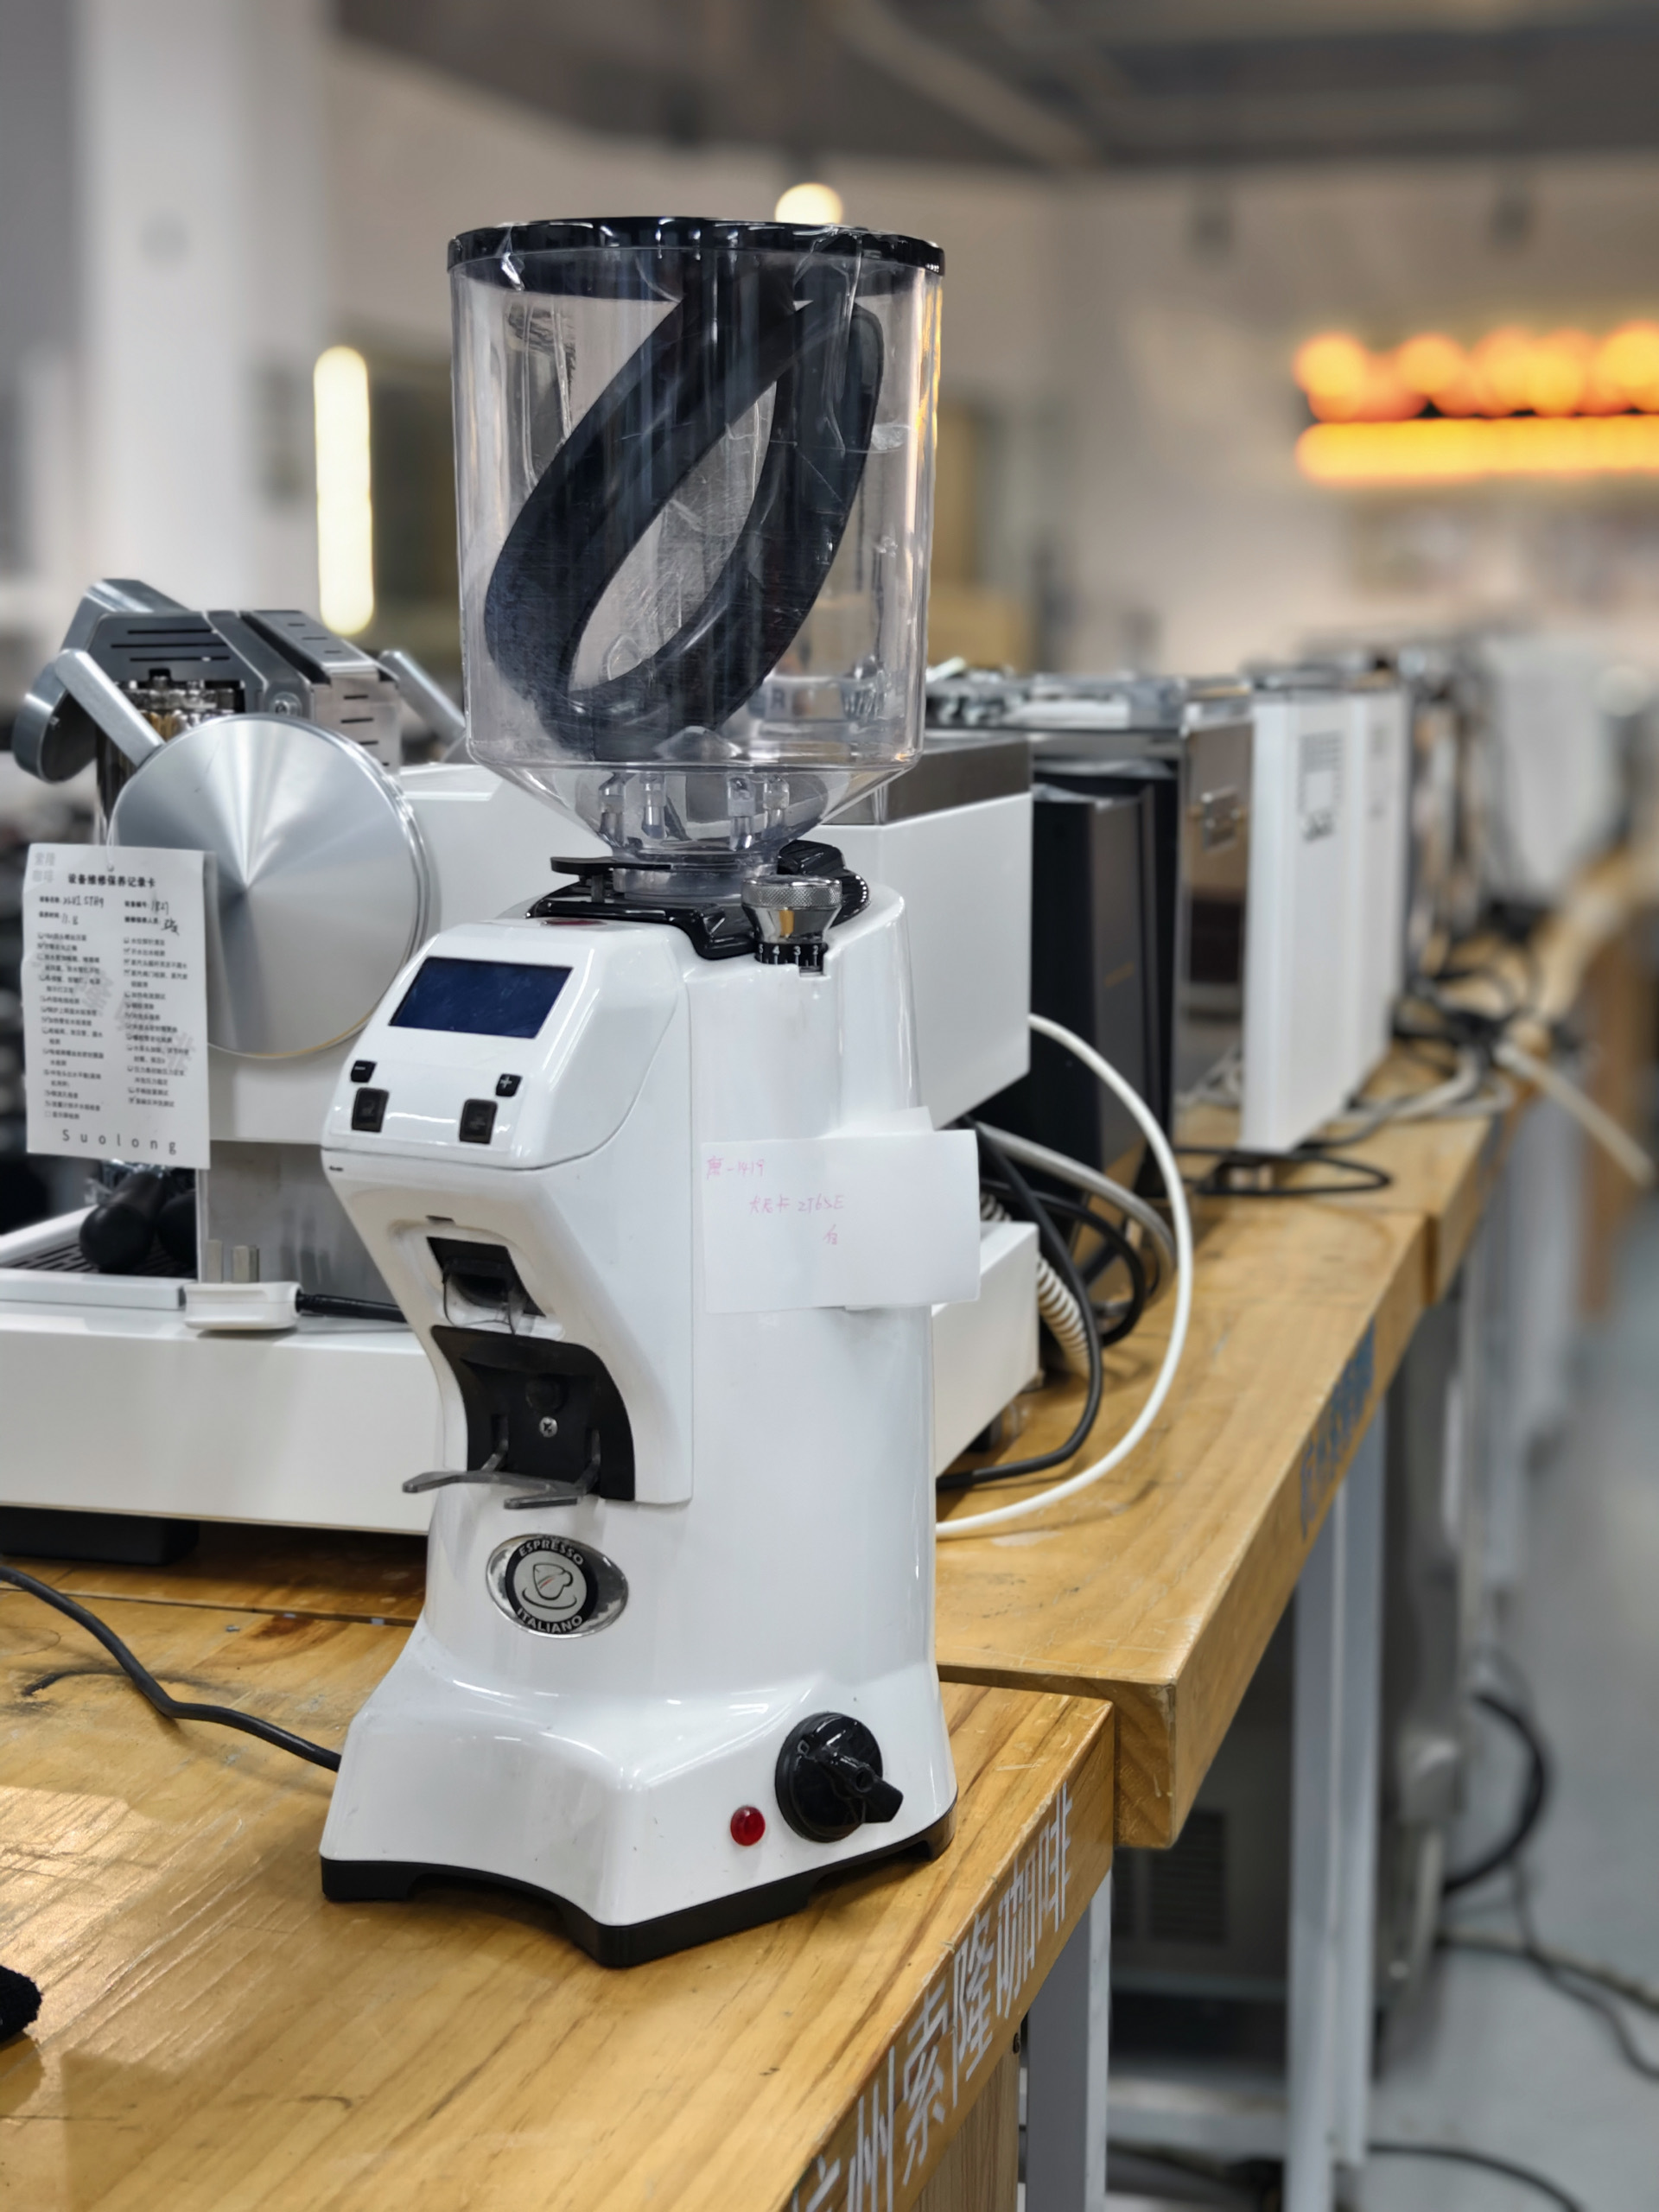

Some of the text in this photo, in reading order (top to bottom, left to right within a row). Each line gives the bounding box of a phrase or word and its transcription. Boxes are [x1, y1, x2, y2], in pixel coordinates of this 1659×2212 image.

[772, 945, 780, 955] 4
[794, 945, 801, 956] 3
[813, 944, 819, 955] 2
[62, 1128, 176, 1155] Suolong
[519, 1539, 584, 1566] ESPRESSO
[518, 1607, 583, 1633] ITALIANO
